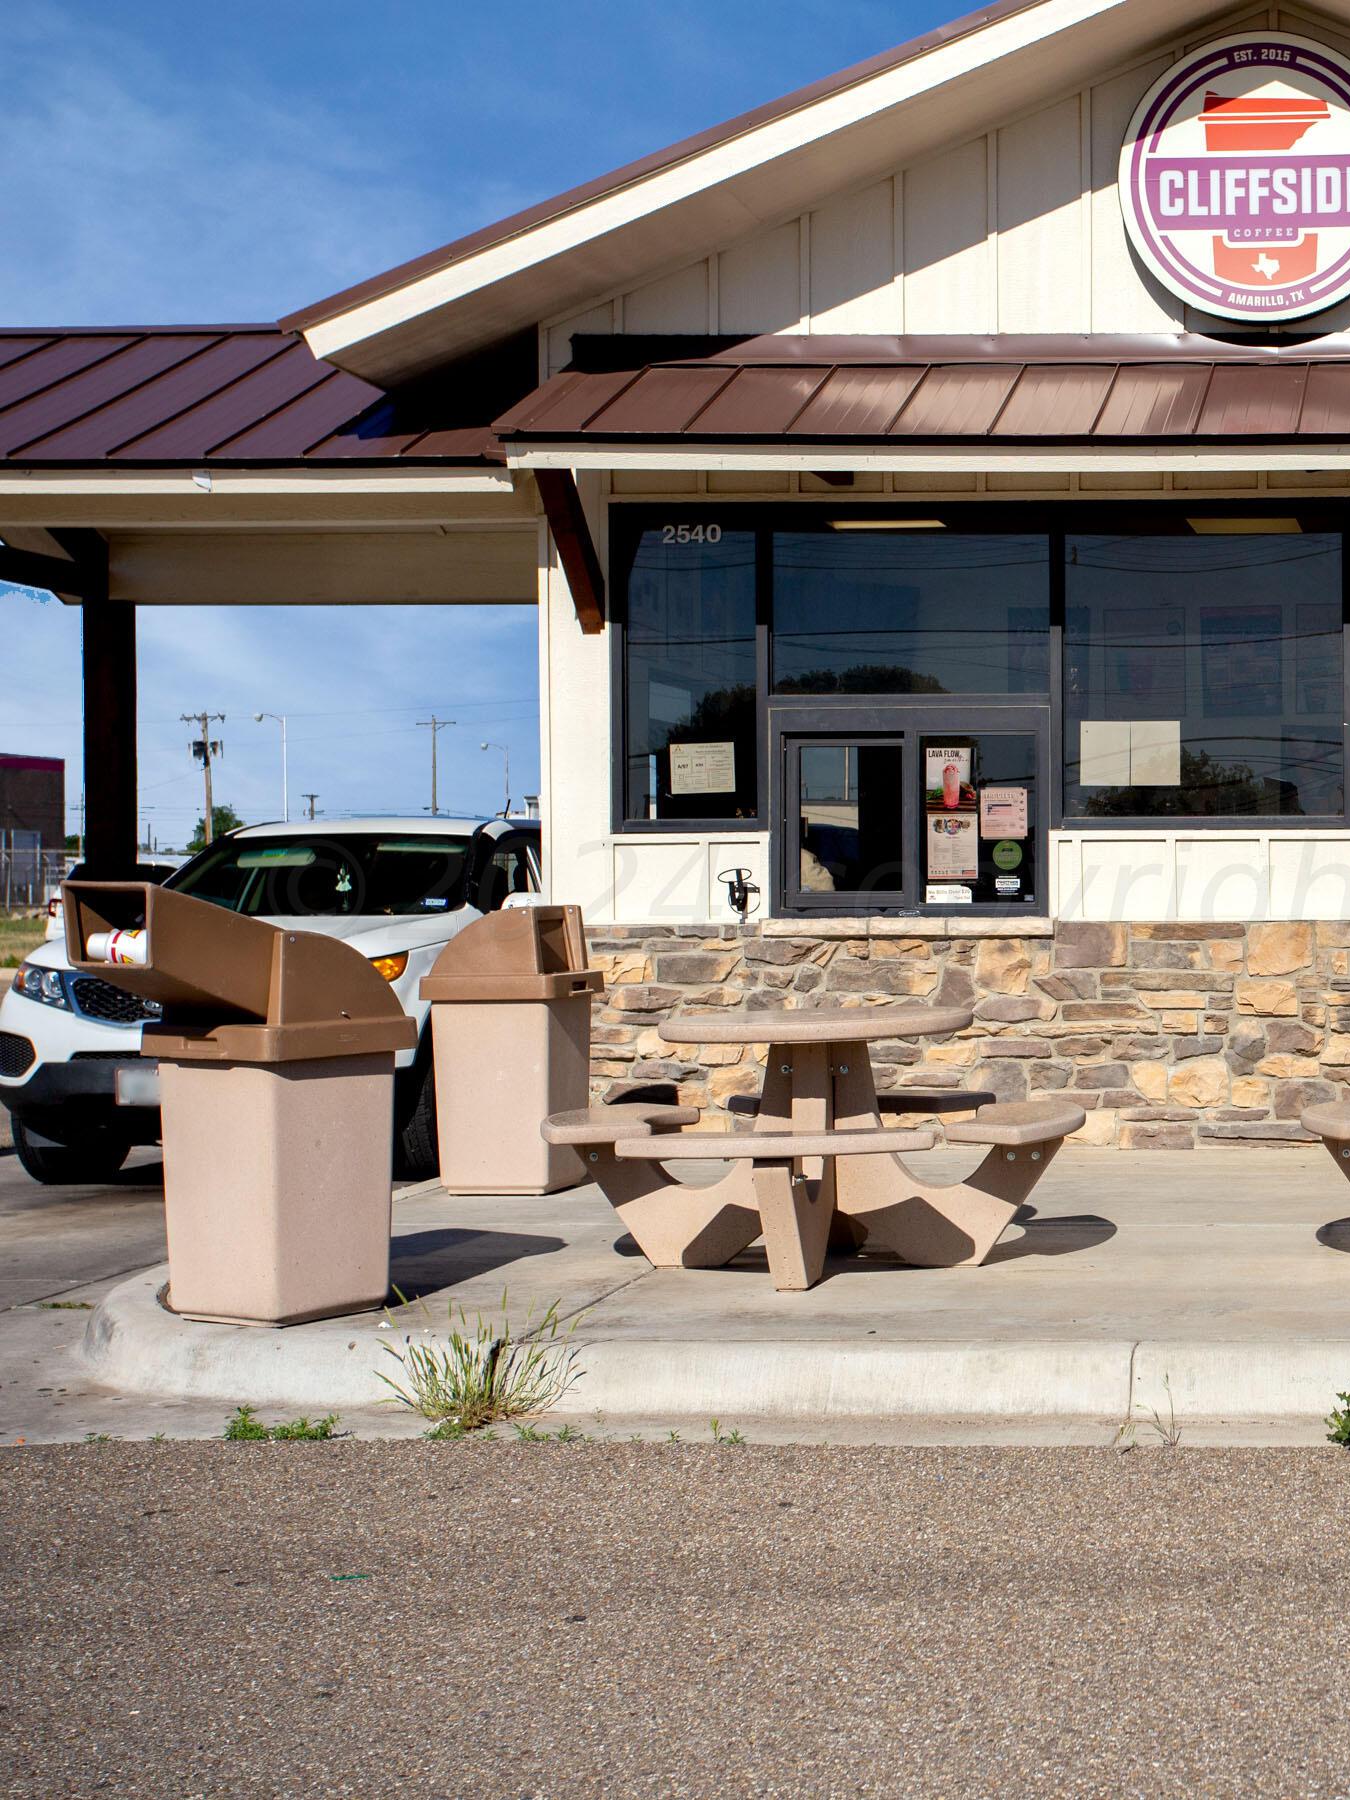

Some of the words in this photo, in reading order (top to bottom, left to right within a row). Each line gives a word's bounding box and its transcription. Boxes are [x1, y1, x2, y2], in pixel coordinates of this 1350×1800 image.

[1233, 49, 1257, 63] EST.
[1261, 49, 1291, 62] 2015
[1233, 227, 1293, 238] COFFEE
[1227, 292, 1289, 307] AMARILLO,
[1291, 289, 1305, 302] TX
[662, 523, 722, 545] 2540
[928, 750, 943, 758] LAVA
[944, 750, 960, 758] FLOW
